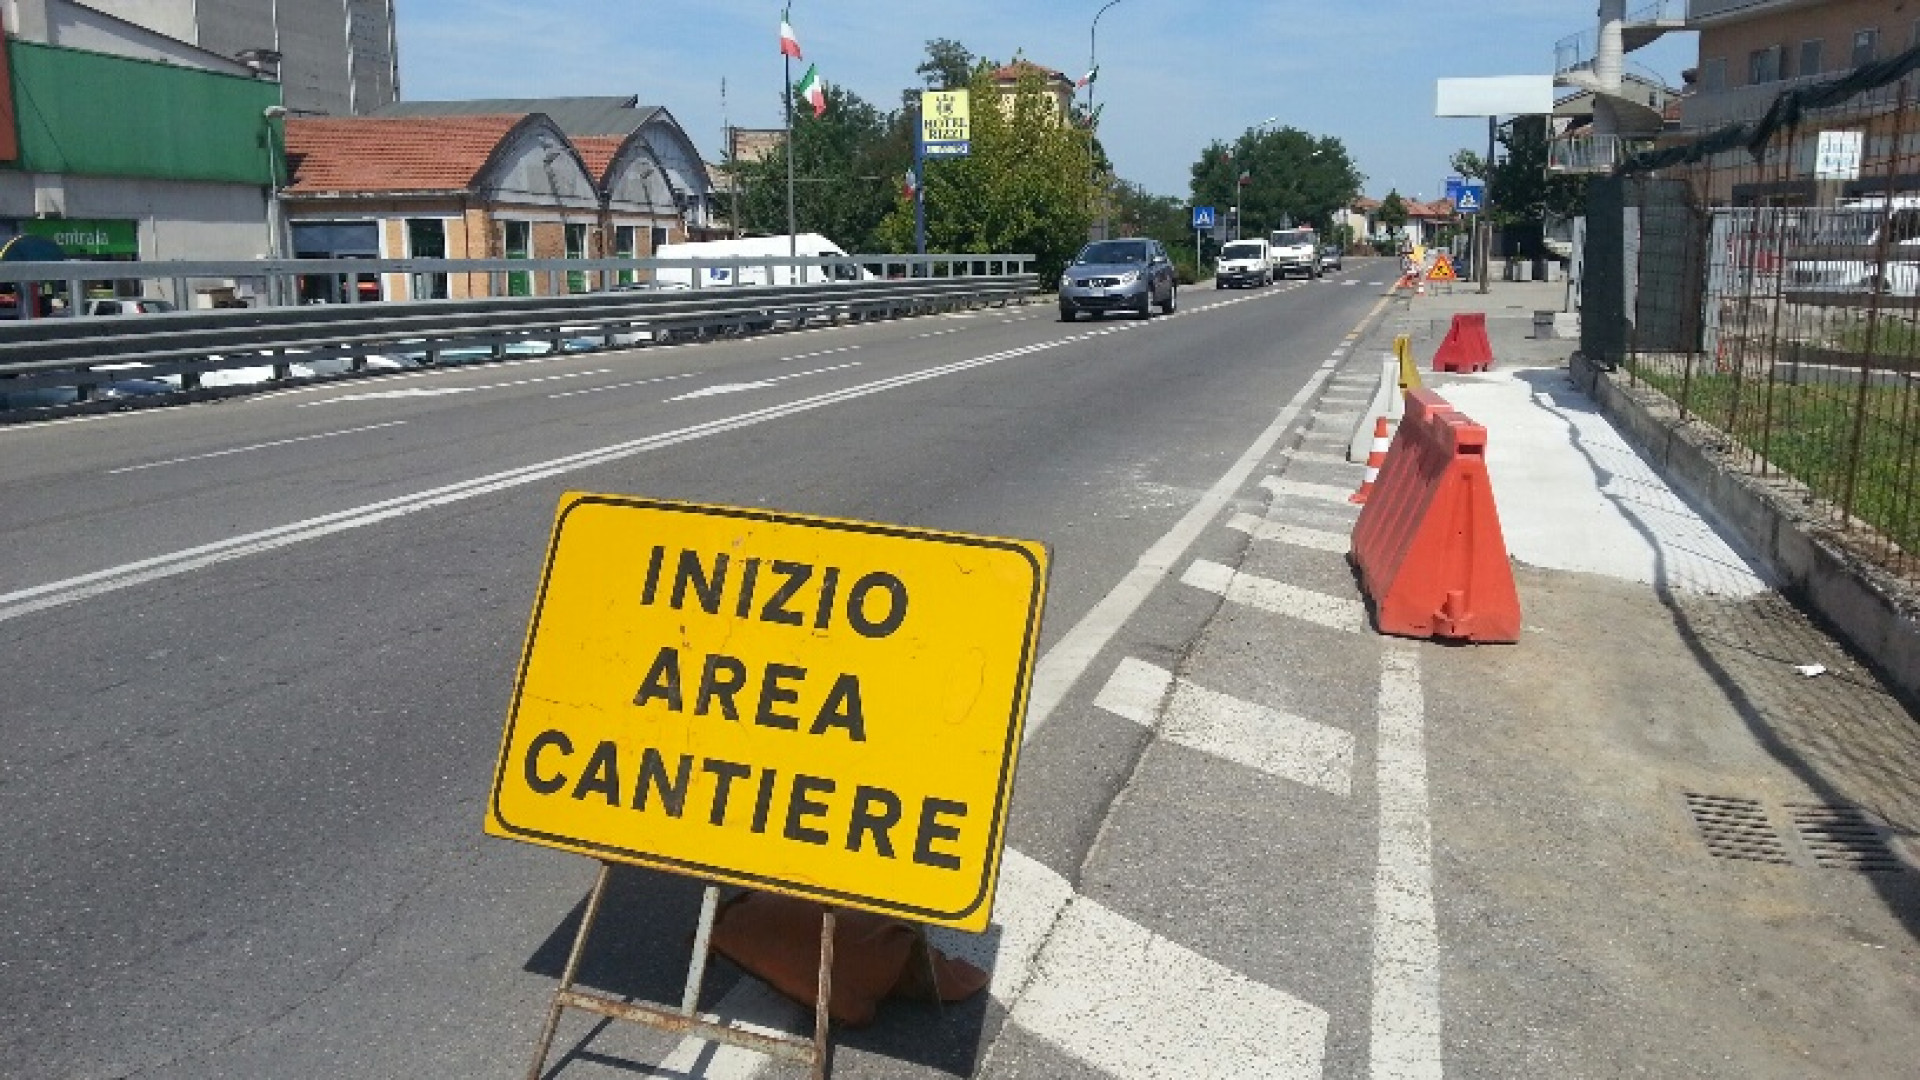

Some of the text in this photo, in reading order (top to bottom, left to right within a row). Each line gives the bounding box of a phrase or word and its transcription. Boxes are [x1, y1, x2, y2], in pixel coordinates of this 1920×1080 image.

[924, 117, 968, 128] HOTEL
[929, 129, 963, 140] RIZZI
[55, 228, 109, 245] entraa
[640, 545, 909, 639] INIZIO
[633, 646, 867, 742] AREA
[524, 728, 968, 871] CANTIERE
